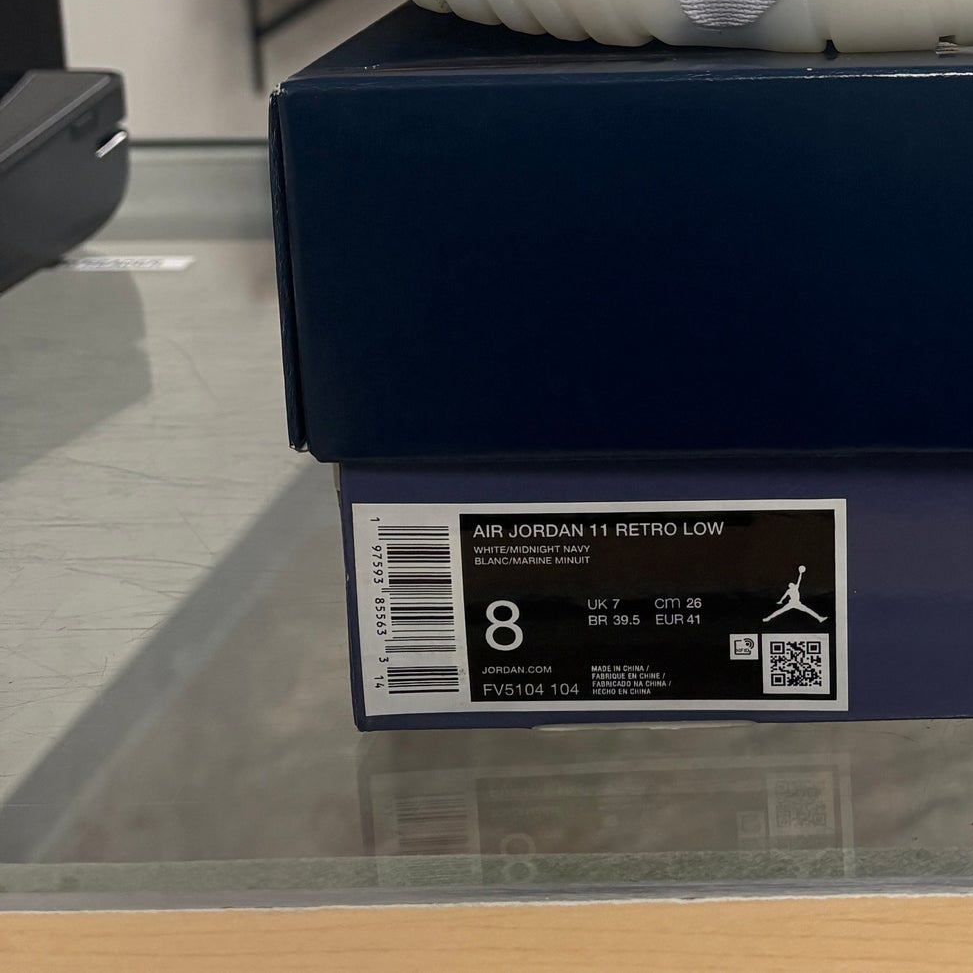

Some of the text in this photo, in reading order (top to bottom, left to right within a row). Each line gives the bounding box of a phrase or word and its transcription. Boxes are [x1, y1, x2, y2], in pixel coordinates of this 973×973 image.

[473, 522, 724, 537] AIR JORDAN 11 RETRO LOW
[372, 546, 383, 583] 97593
[475, 556, 590, 565] BLANC/MARINE MINUIT
[588, 599, 620, 610] UK 7
[687, 598, 701, 608] 26
[375, 598, 386, 635] 85563
[589, 615, 640, 625] BR 39.5
[656, 614, 700, 625] EUR 41
[486, 600, 523, 651] 8
[482, 666, 552, 674] JORDAN.COM
[592, 672, 626, 680] FABRIQUE
[483, 683, 579, 696] FV5104 104
[592, 680, 631, 688] FABRICADO
